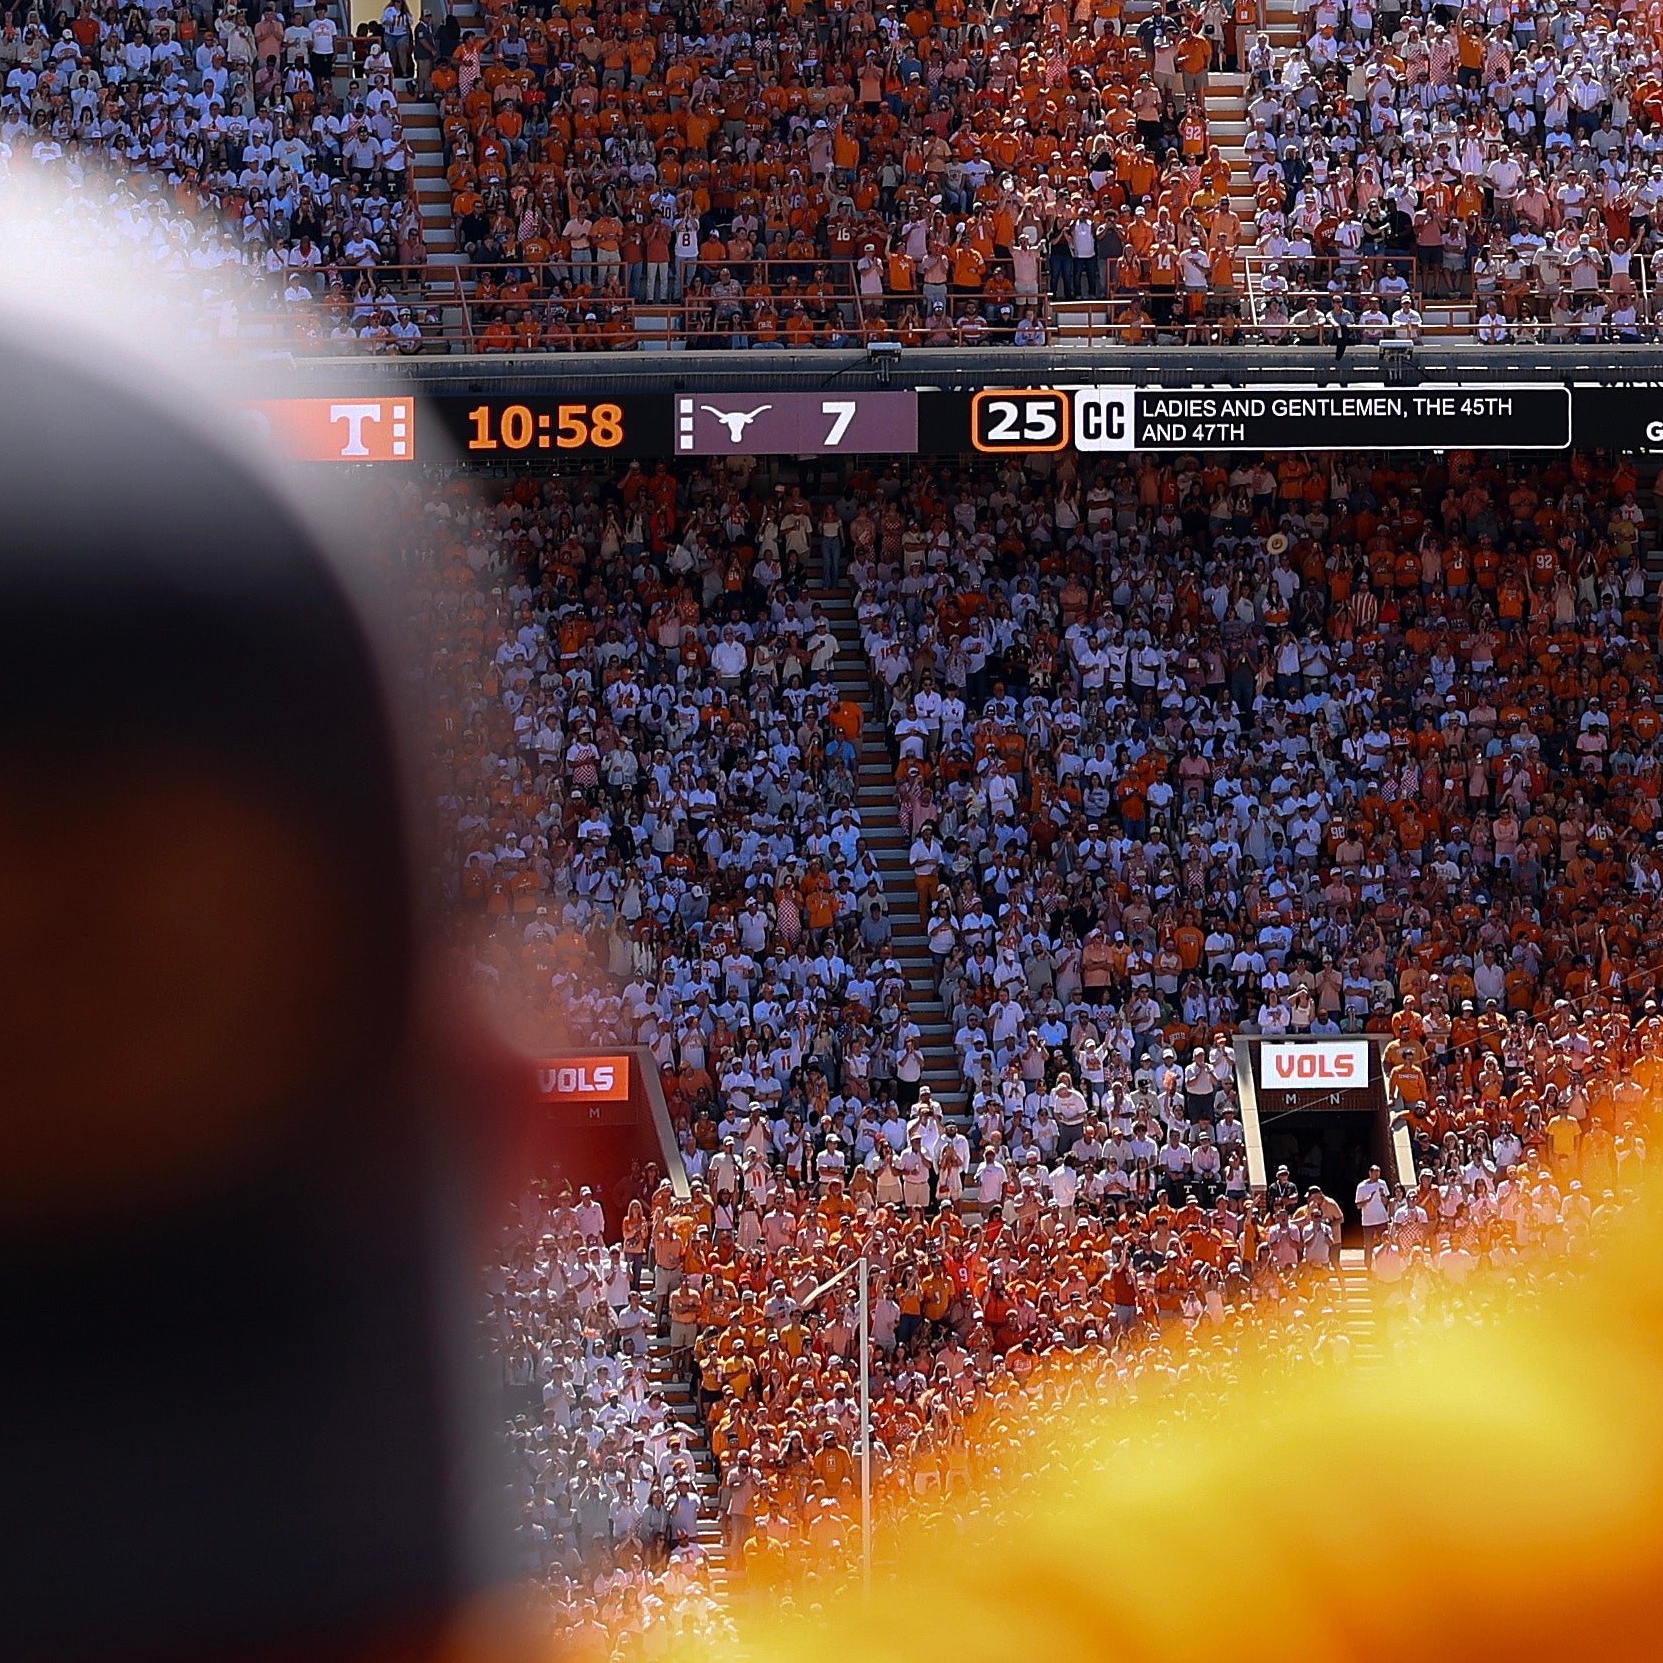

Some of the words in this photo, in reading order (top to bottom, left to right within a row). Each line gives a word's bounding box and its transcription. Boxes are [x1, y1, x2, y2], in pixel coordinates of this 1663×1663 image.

[1186, 126, 1201, 140] 92
[683, 233, 690, 246] 8
[837, 228, 850, 240] 16
[1158, 254, 1171, 269] 14
[1142, 399, 1216, 417] LADIES
[1221, 399, 1266, 417] AND
[1271, 398, 1408, 418] GENTLEMEN,
[1413, 398, 1455, 416] THE
[1460, 398, 1513, 416] 45TH
[468, 403, 624, 449] 10:58
[822, 401, 857, 446] 7
[986, 401, 1058, 442] 25
[1082, 401, 1125, 440] CC
[330, 404, 381, 456] T
[1141, 424, 1187, 441] AND
[1192, 423, 1245, 441] 47TH
[1537, 555, 1552, 568] 92
[1331, 827, 1344, 839] 98
[781, 1056, 791, 1070] 11
[1276, 1054, 1354, 1078] VOLS
[1285, 1094, 1296, 1104] M
[1330, 1094, 1340, 1104] N
[1184, 1185, 1192, 1194] T
[1208, 1185, 1216, 1194] T
[959, 1268, 968, 1282] 9
